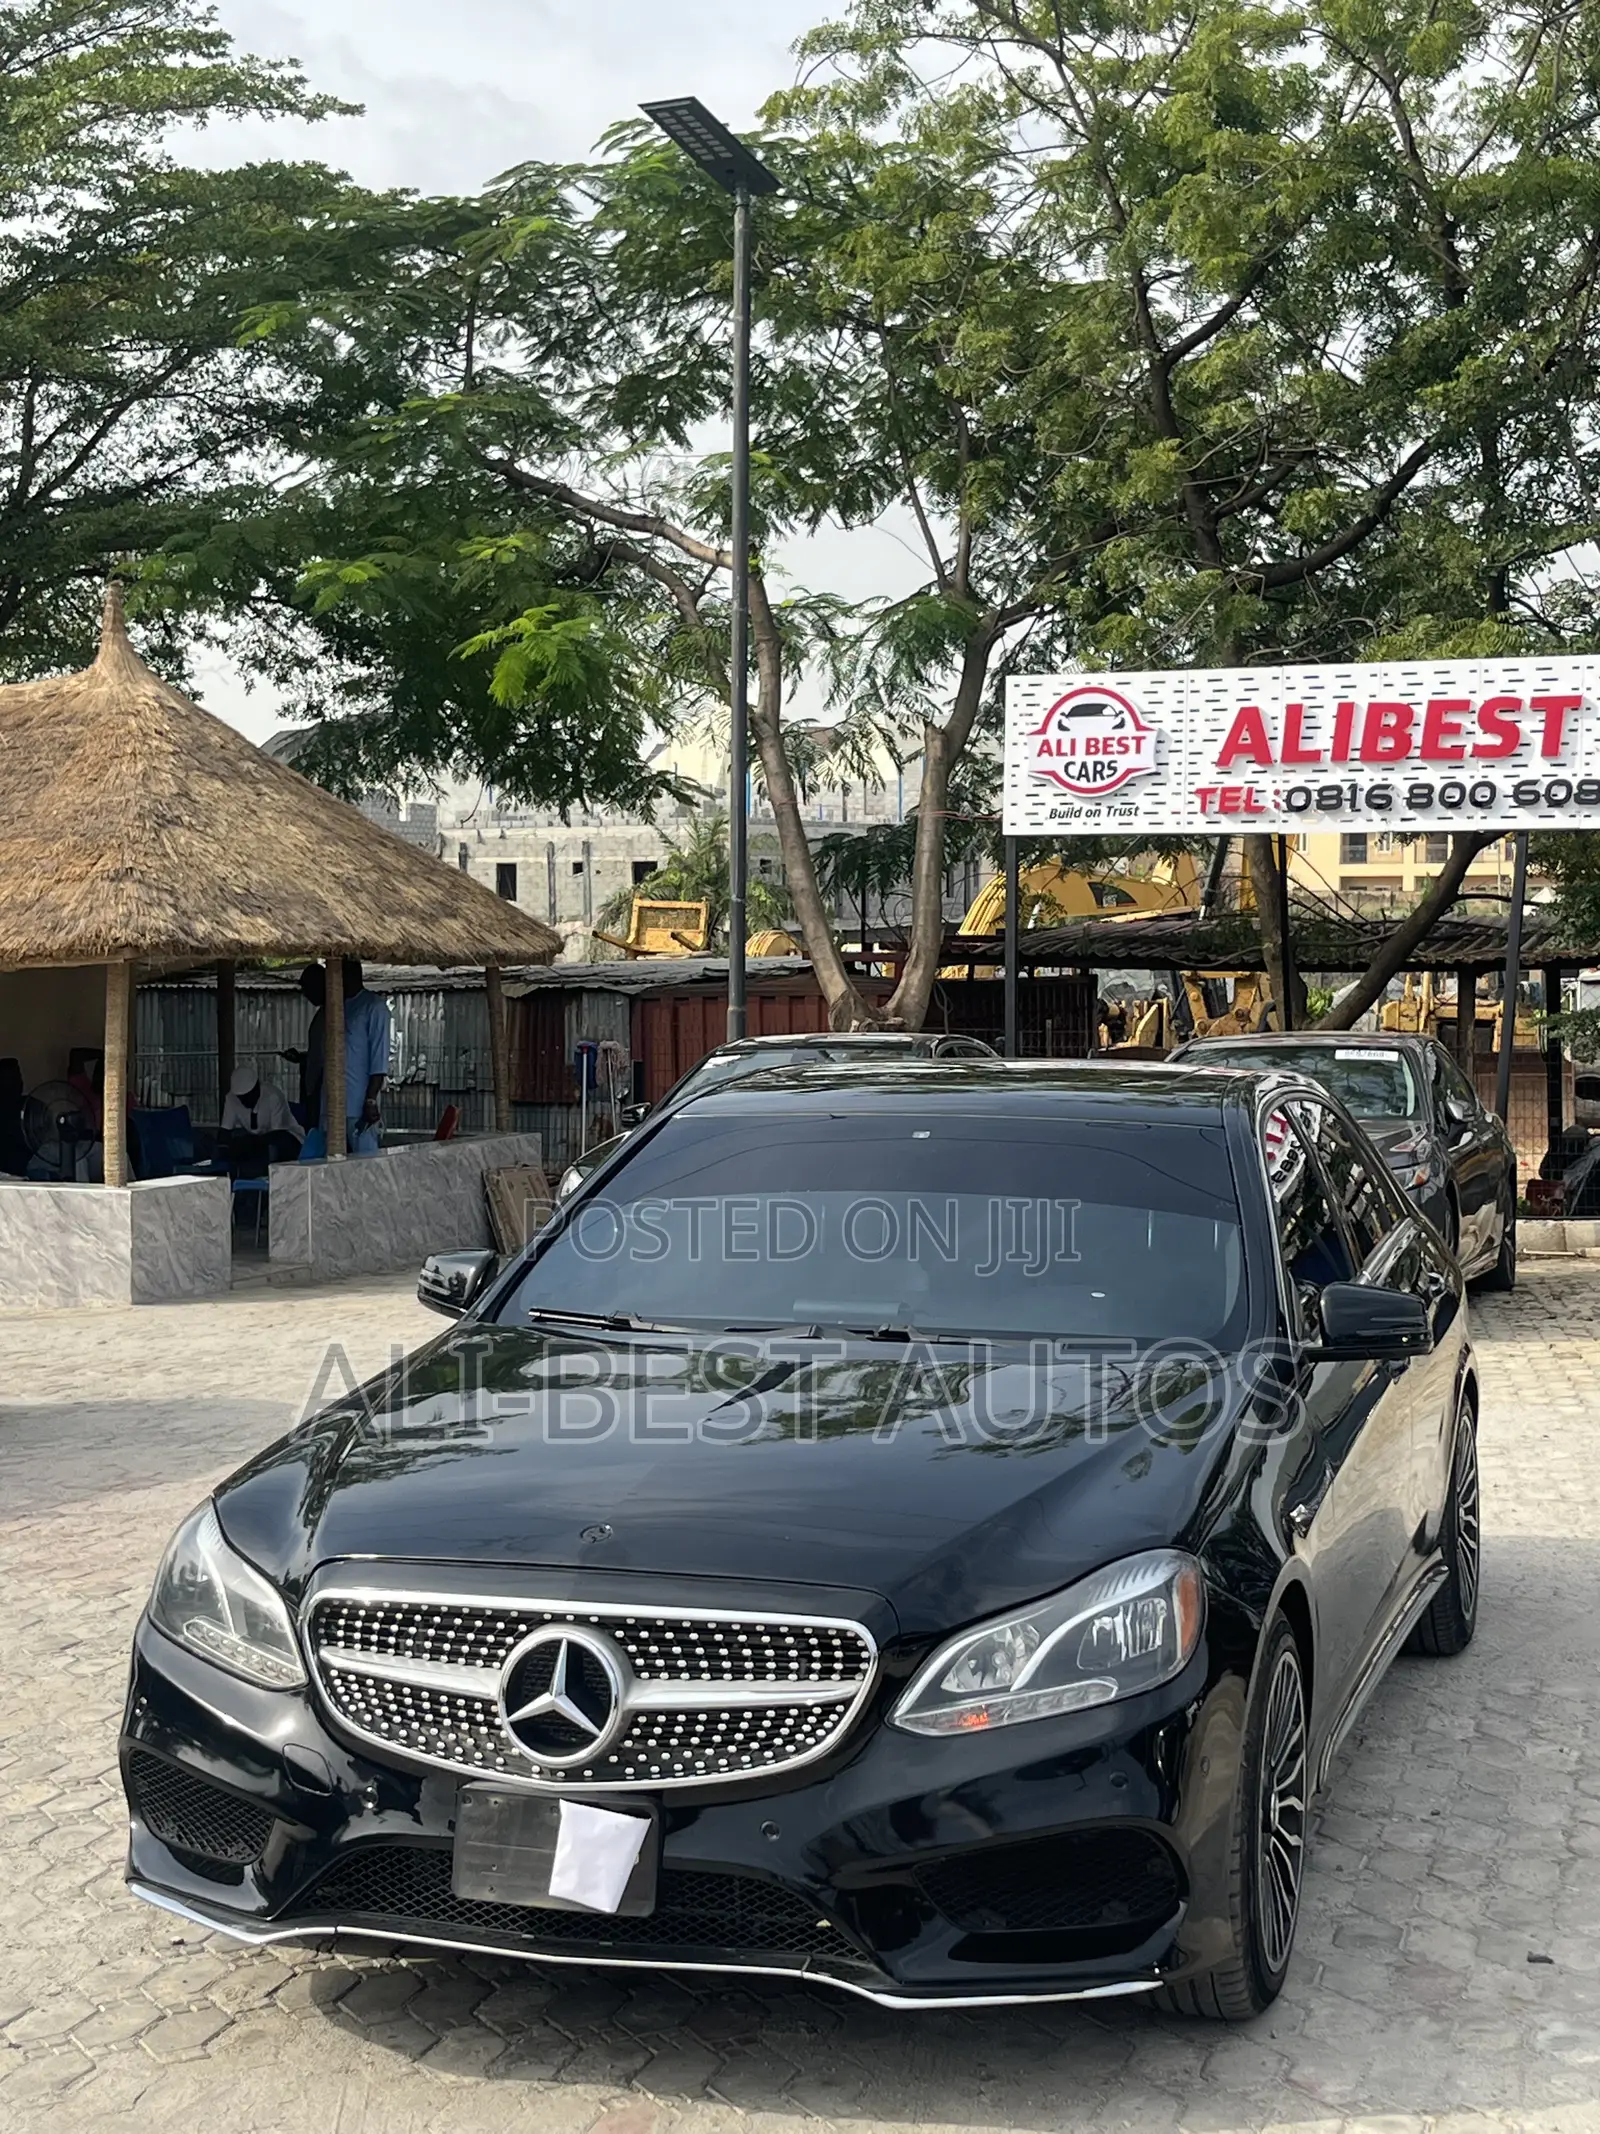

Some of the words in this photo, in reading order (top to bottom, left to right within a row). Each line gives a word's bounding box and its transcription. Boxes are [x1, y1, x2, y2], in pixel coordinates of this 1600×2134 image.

[1215, 695, 1583, 768] ALIBEST
[1036, 738, 1077, 758] ALI
[1084, 735, 1147, 756] BEST
[1063, 759, 1118, 783] CARS
[1405, 780, 1497, 810] 800
[1512, 778, 1600, 807] 608
[1049, 806, 1083, 820] Build
[1084, 808, 1102, 819] on
[1105, 804, 1141, 818] Trust
